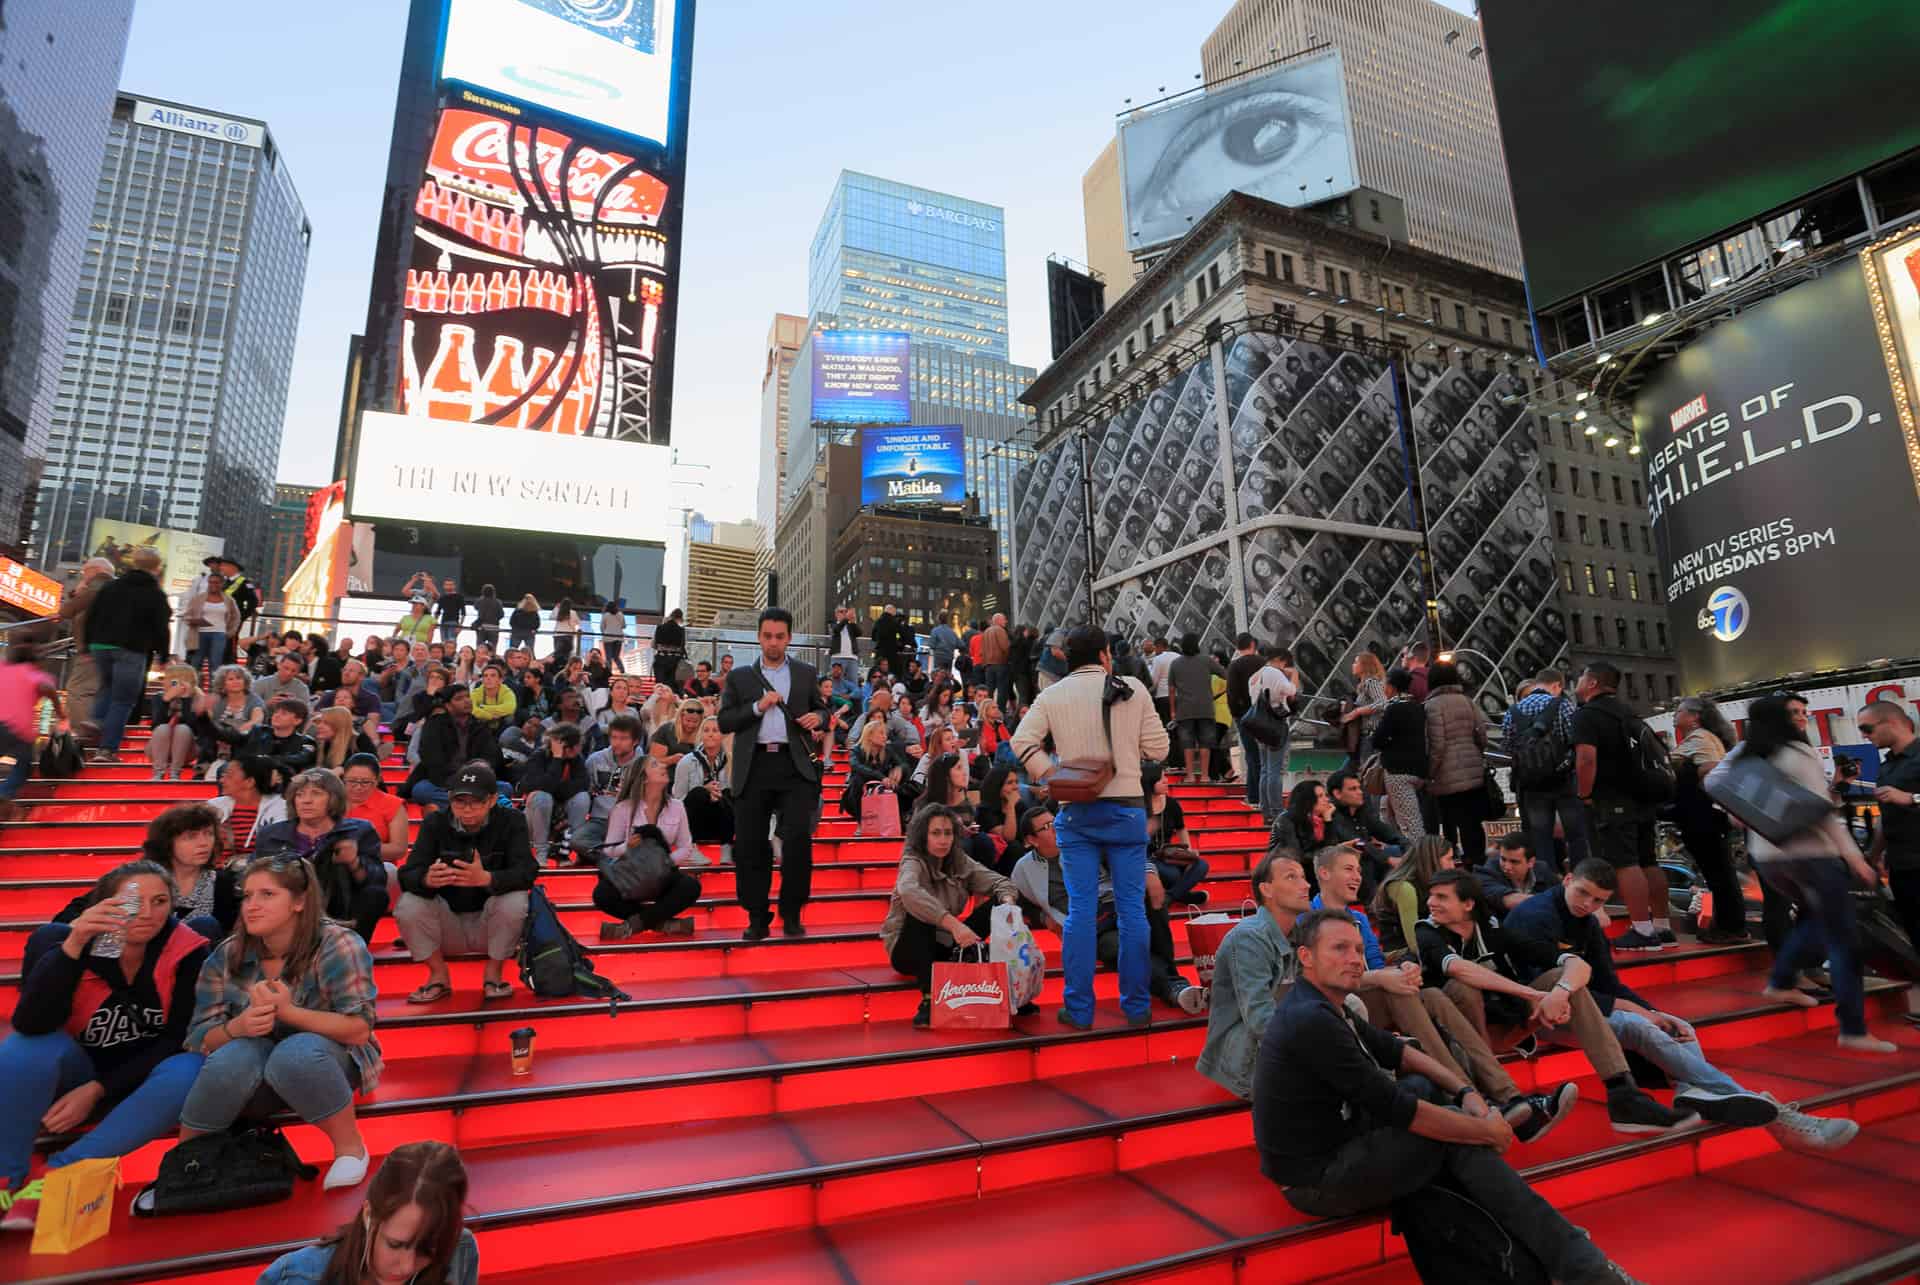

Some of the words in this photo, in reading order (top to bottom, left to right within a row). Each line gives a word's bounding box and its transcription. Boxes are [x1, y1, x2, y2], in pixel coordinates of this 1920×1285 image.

[151, 109, 219, 134] Allianz
[926, 206, 995, 231] BARCLAYS
[1670, 396, 1708, 432] MARVEL
[1649, 412, 1730, 482] AGENTS
[1741, 382, 1795, 421] OF
[888, 479, 942, 497] Matilda
[1672, 562, 1680, 580] A
[1680, 549, 1704, 576] NEW
[1704, 539, 1725, 561] TV
[1728, 517, 1795, 553] SERIES
[1684, 572, 1696, 593] 24
[1695, 542, 1781, 585] TUESDAYS
[1785, 527, 1836, 556] 8PM
[1698, 612, 1716, 630] abc
